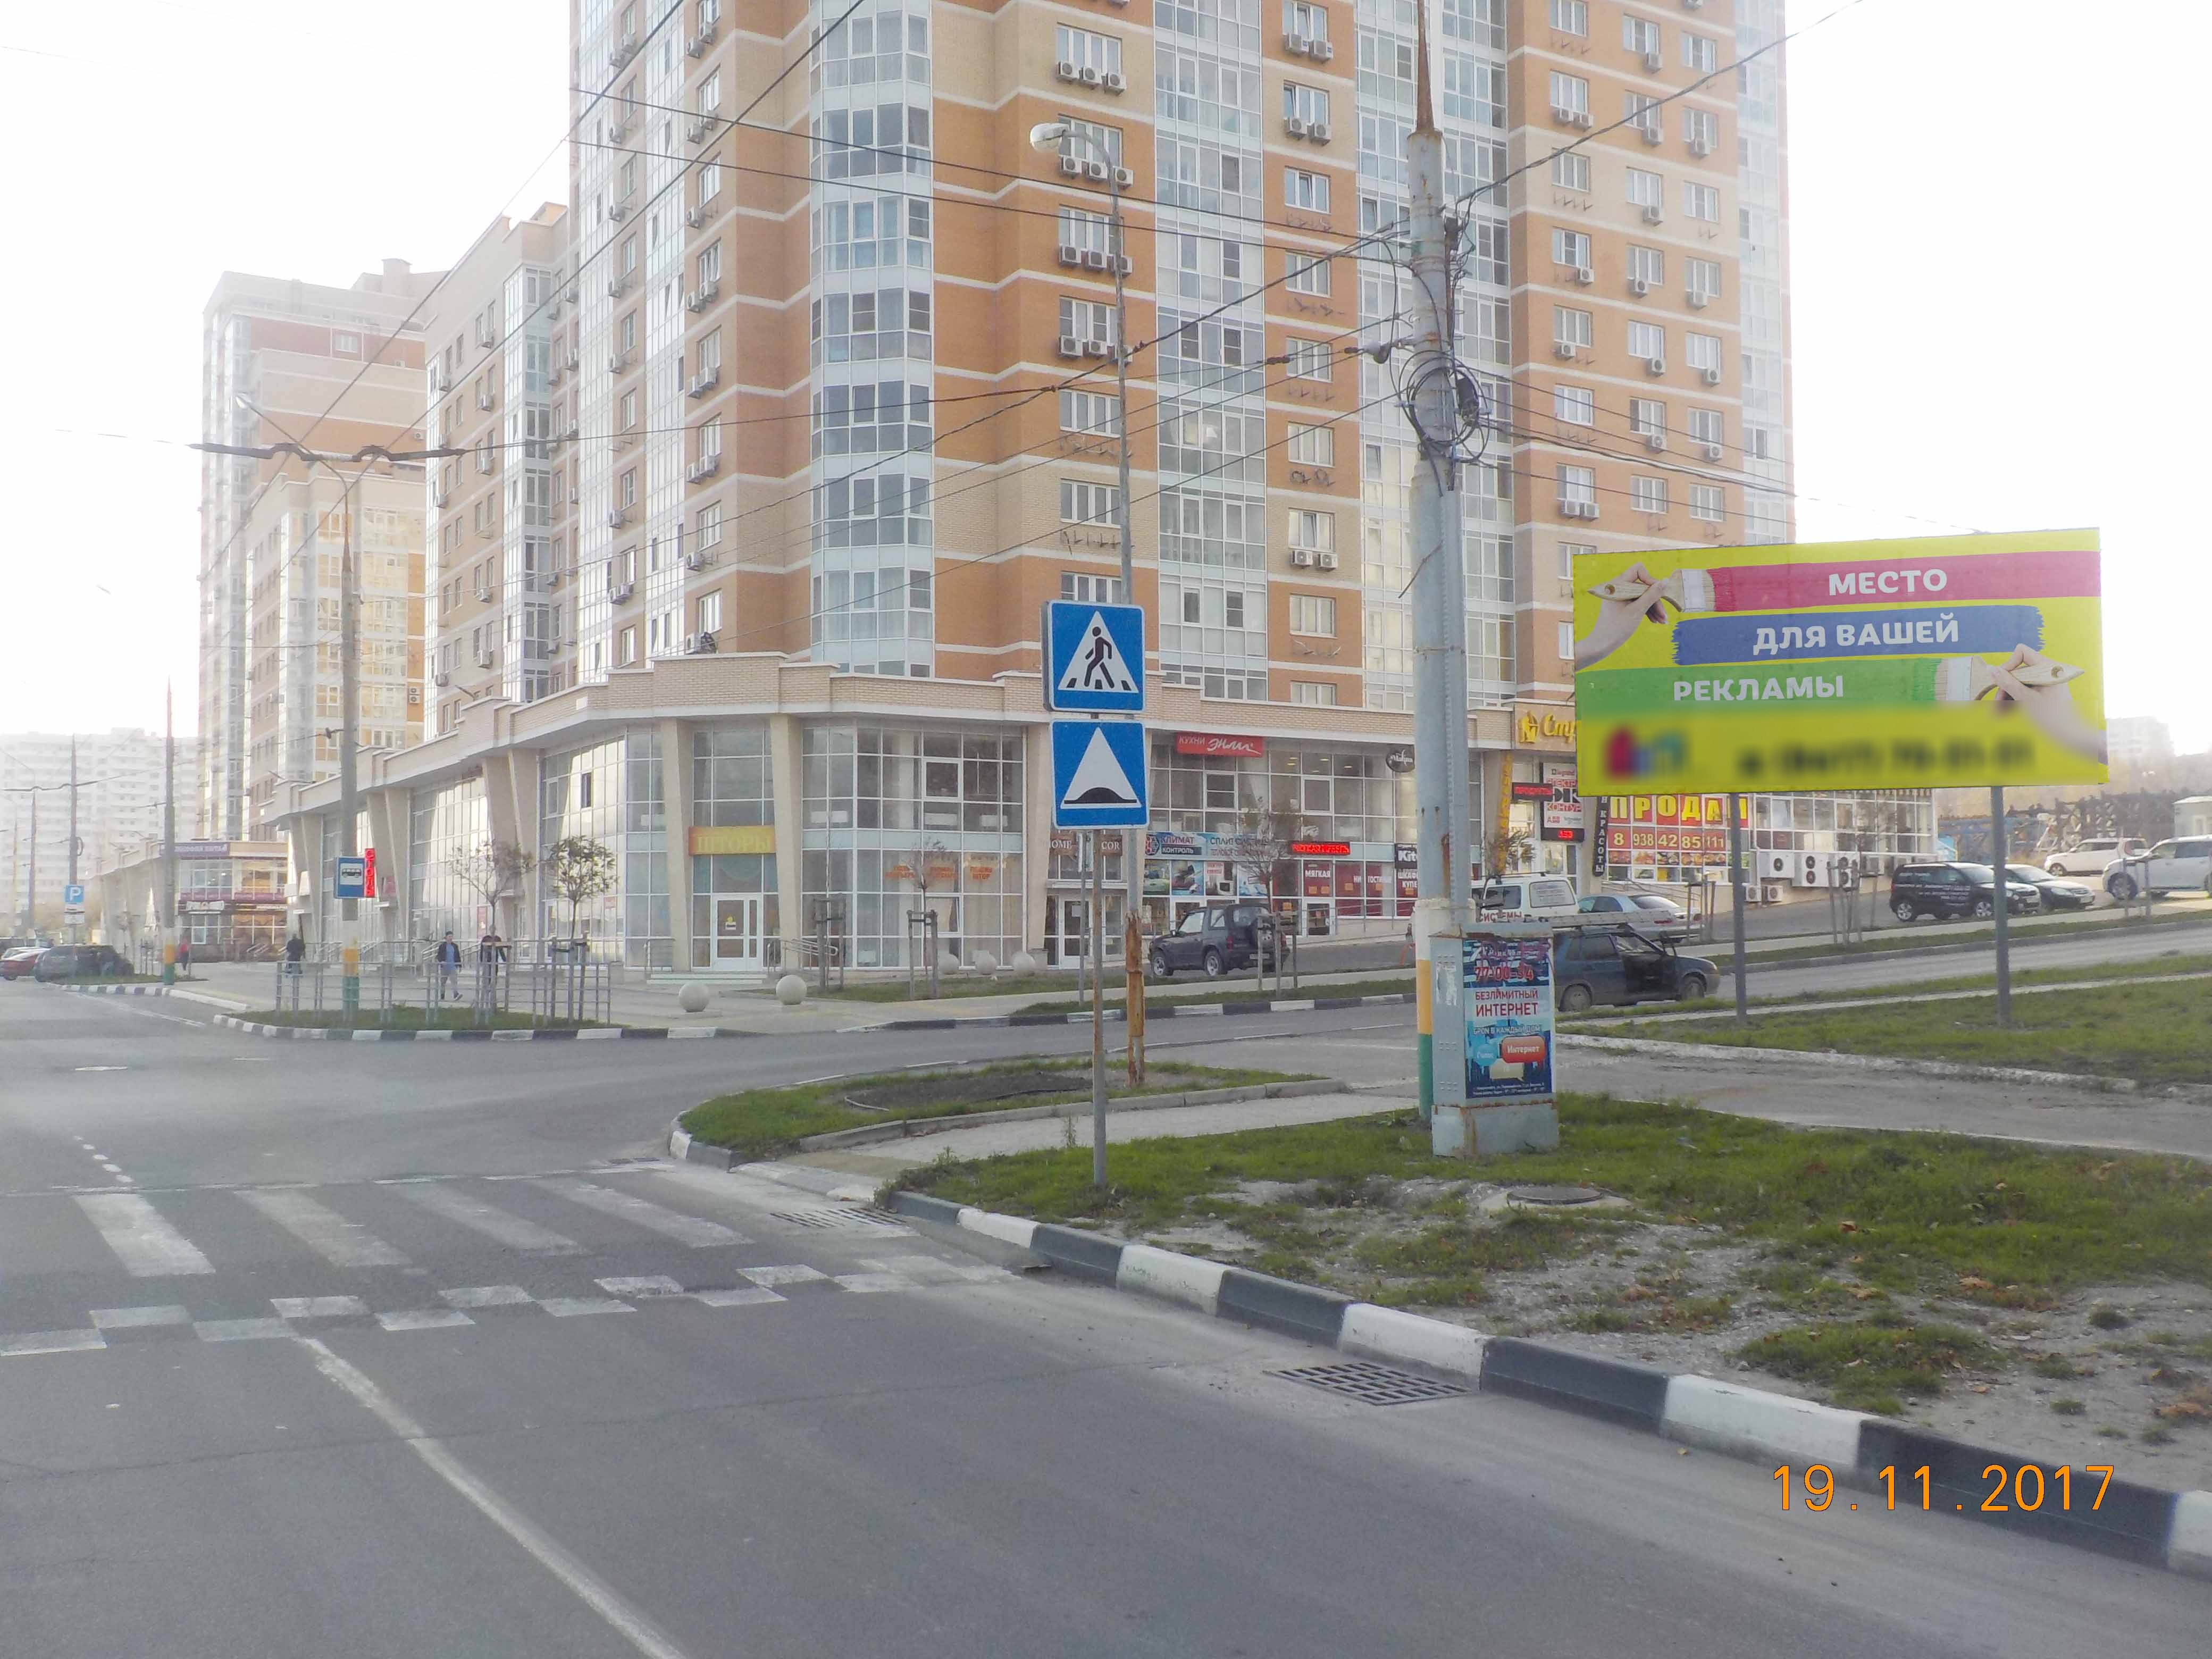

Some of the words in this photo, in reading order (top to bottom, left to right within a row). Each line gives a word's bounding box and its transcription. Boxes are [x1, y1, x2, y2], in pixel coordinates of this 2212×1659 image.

[1829, 569, 1947, 596] МЕСТО
[1753, 626, 1826, 655] ДЛЯ
[1837, 613, 1958, 646] ВАШЕЙ
[1674, 676, 1843, 700] РЕКЛАМЫ
[1179, 735, 1205, 745] КУХНИ
[698, 836, 772, 851] ШТОРЫ
[1051, 840, 1073, 849] OME
[1595, 810, 1608, 872] КРАСОТЫ
[1614, 833, 1626, 846] 8
[1633, 833, 1654, 846] 938
[1658, 834, 1678, 847] 42
[1681, 835, 1702, 849] 85
[1706, 836, 1725, 848] 111
[1479, 911, 1522, 923] СИСТЕМЫ
[1476, 987, 1538, 1000] БЕЗЛИМИТНЫЙ
[1476, 1002, 1538, 1017] ИНТЕРНЕТ
[1507, 1045, 1540, 1054] Интернет
